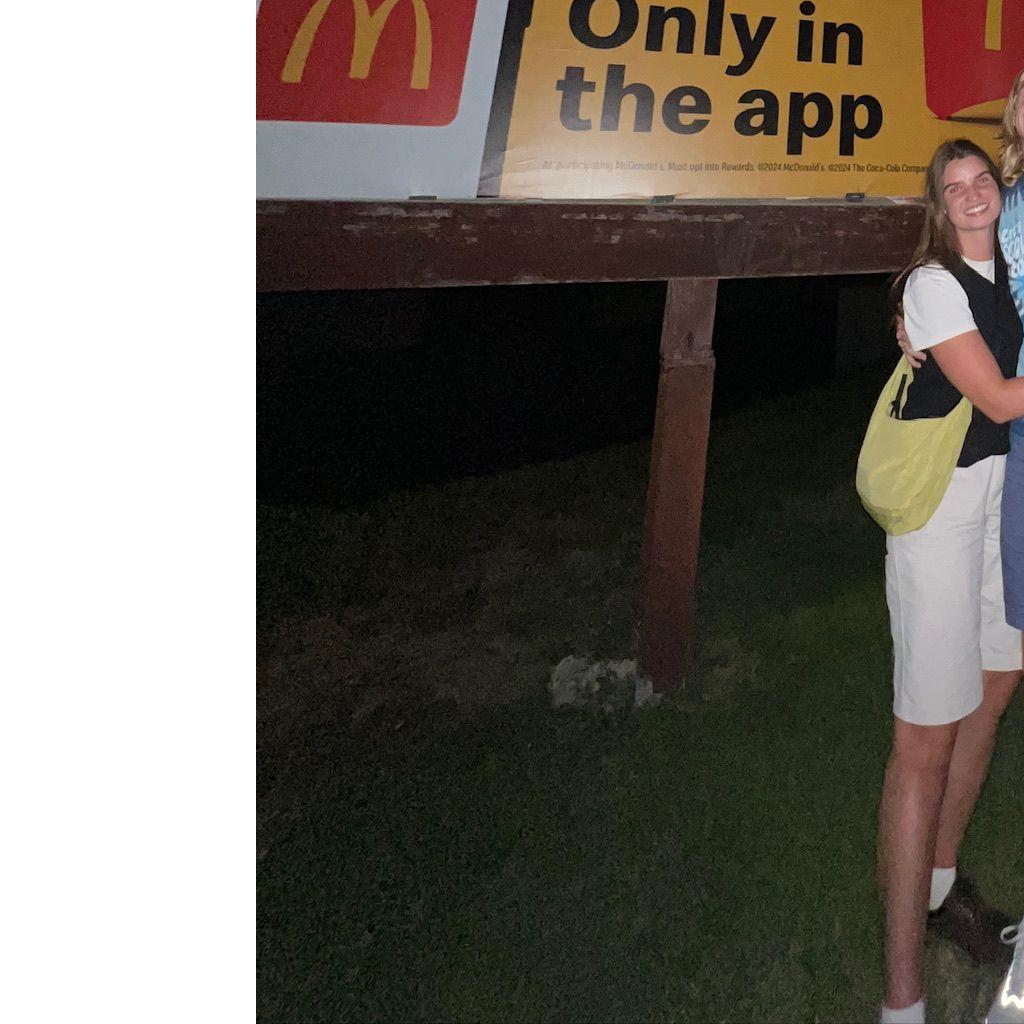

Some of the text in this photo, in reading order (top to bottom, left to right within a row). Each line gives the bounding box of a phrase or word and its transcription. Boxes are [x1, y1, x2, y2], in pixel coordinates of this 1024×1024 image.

[796, 0, 865, 66] in
[556, 63, 884, 157] the app
[853, 163, 865, 172] The
[867, 163, 900, 173] Coca-Cola
